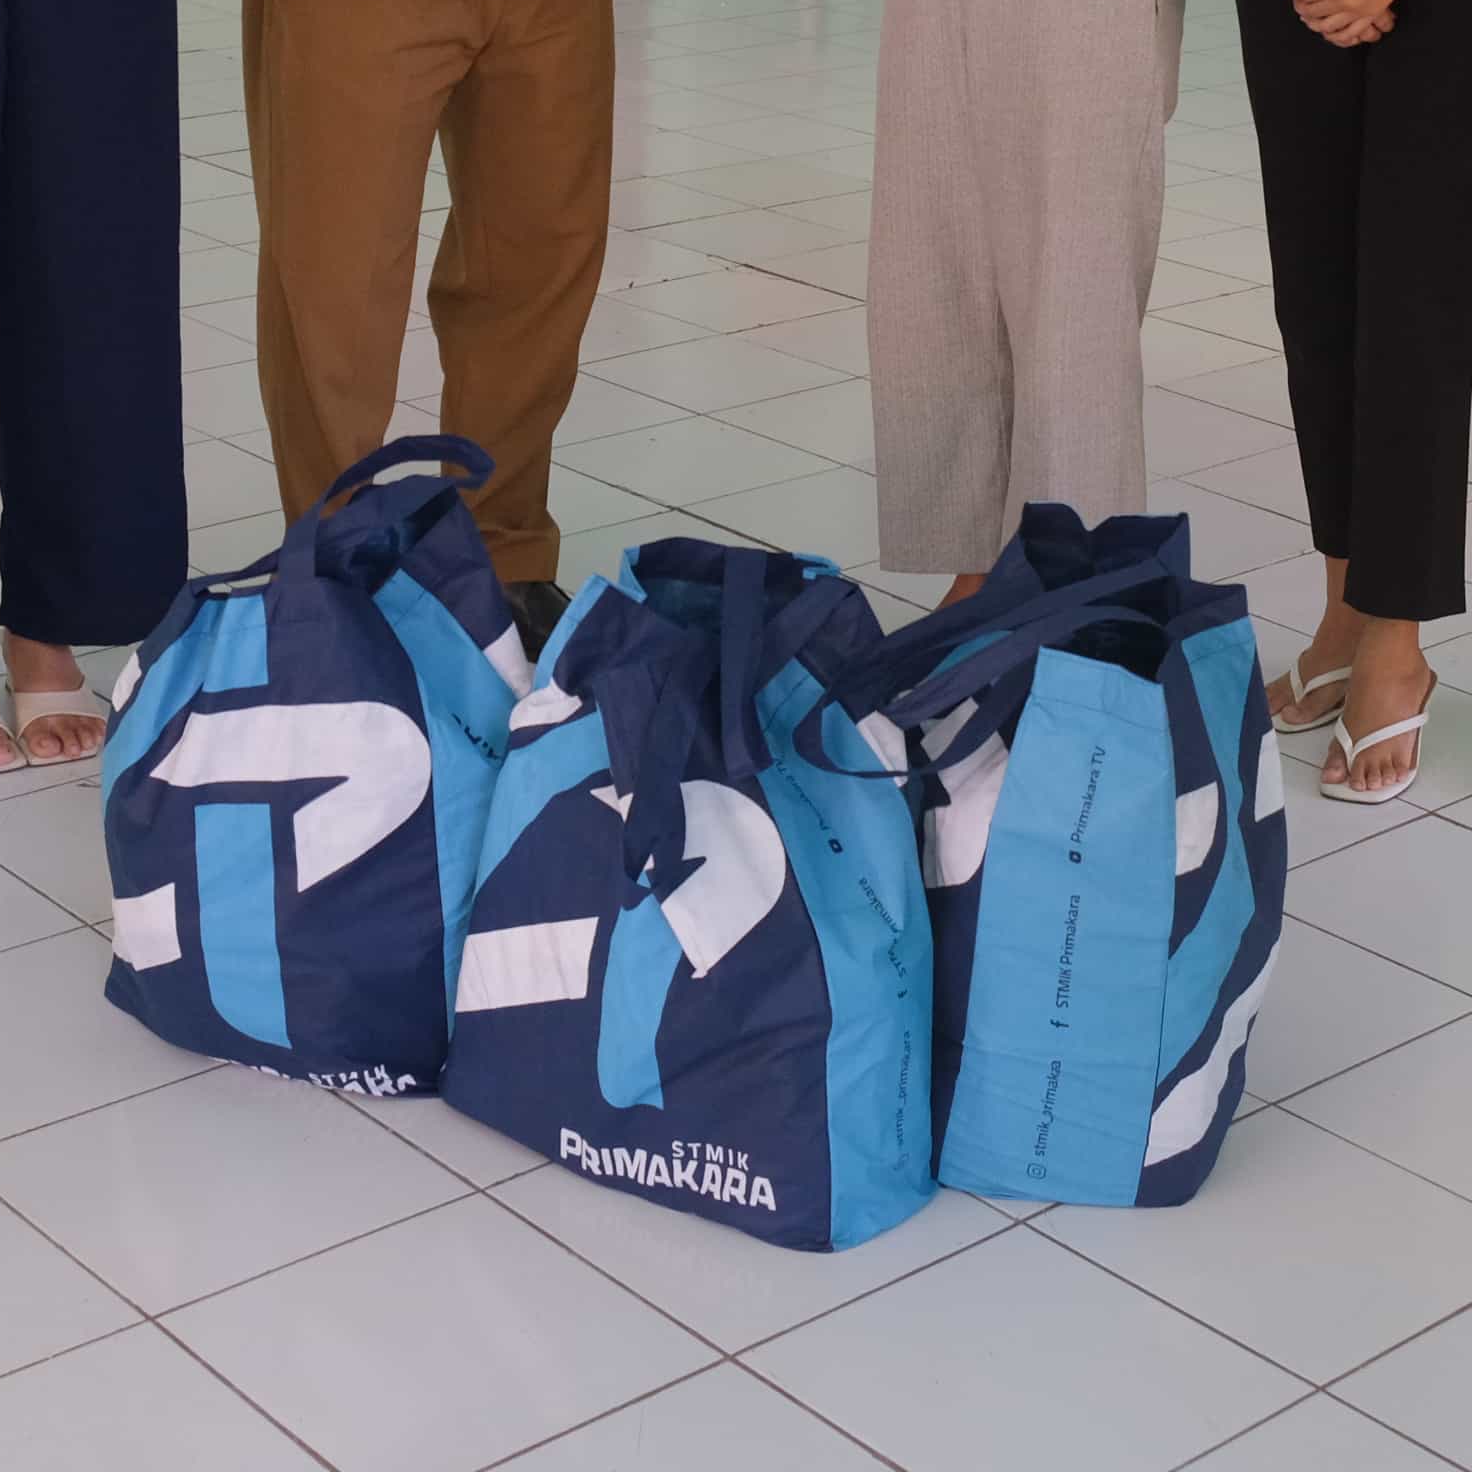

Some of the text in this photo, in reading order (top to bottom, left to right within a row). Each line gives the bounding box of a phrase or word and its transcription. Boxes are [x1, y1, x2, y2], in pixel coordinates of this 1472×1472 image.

[1070, 745, 1107, 843] Primakara TV
[1055, 894, 1081, 1008] STMIK Primakara
[559, 1127, 777, 1212] PRIMAKARA
[671, 1139, 750, 1171] STMIK
